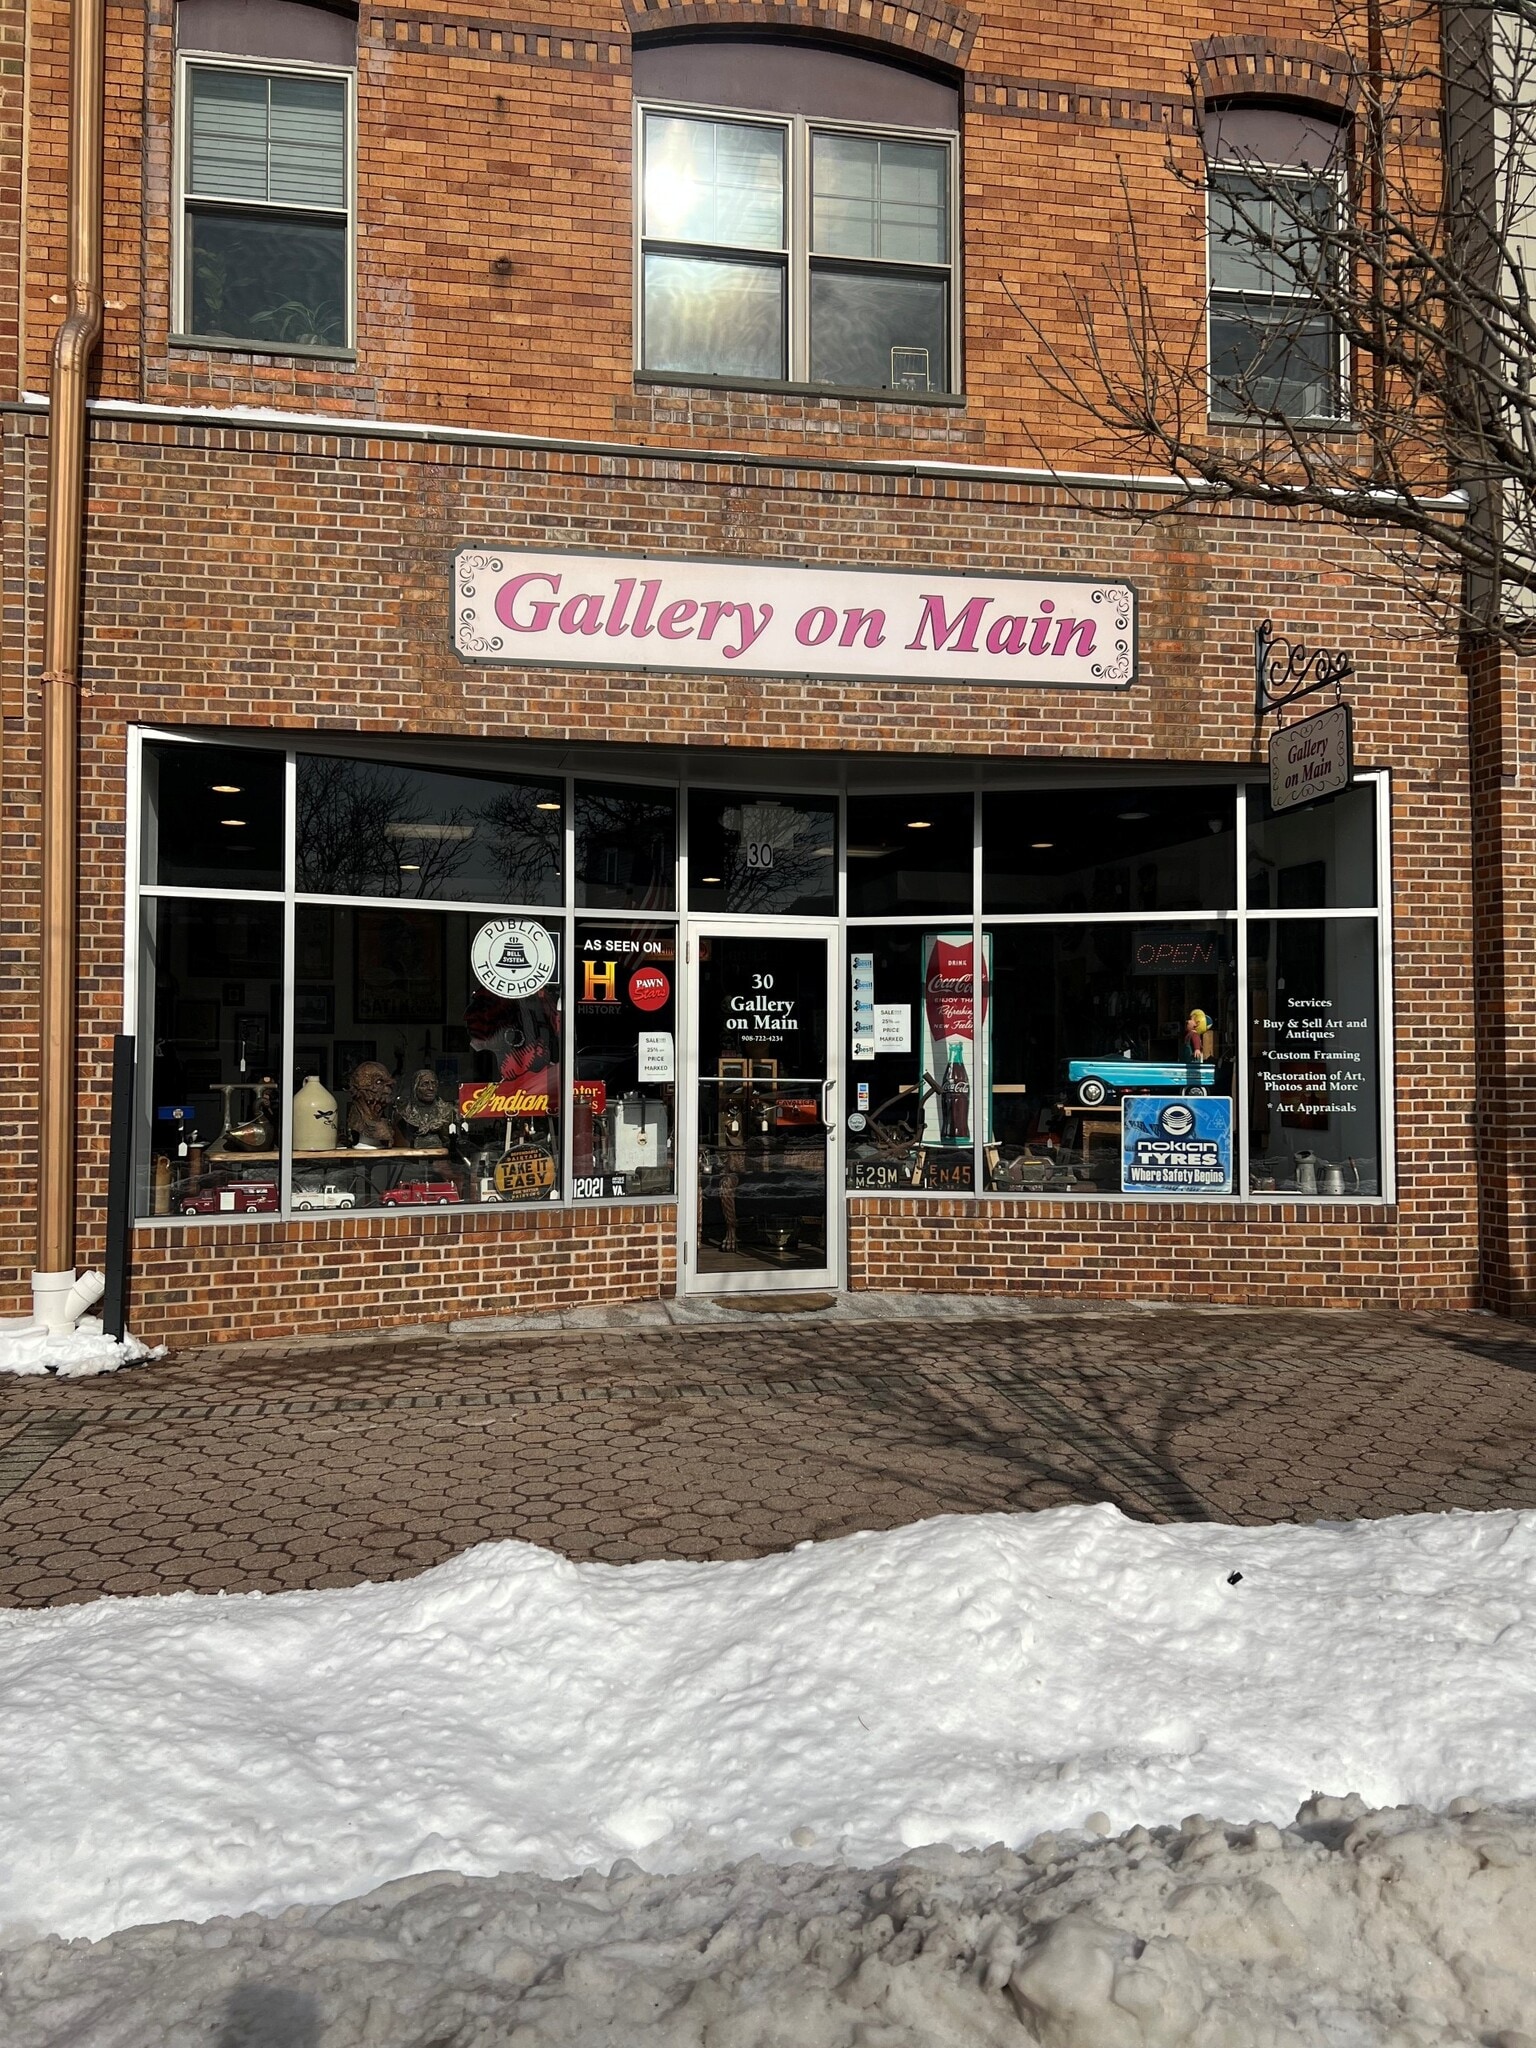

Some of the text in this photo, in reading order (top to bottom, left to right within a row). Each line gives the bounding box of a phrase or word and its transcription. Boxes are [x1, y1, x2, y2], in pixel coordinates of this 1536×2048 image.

[494, 572, 1098, 659] Gallery on Main
[1288, 738, 1328, 764] Gallery
[1285, 758, 1331, 789] on Main
[749, 843, 771, 866] 30
[484, 919, 543, 941] PUBLIC
[583, 939, 661, 953] AS SEEN ON
[1137, 943, 1214, 963] OPEN
[478, 961, 549, 993] TELEPHONE
[582, 960, 618, 1001] H
[636, 979, 663, 988] PAWN
[752, 974, 774, 989] 30
[633, 987, 666, 1001] Stars
[577, 1005, 621, 1014] HISTORY
[731, 995, 795, 1017] Gallery
[1287, 998, 1332, 1008] Services
[726, 1014, 799, 1030] on Main
[1263, 1018, 1367, 1031] Buy & Sell Art and
[1286, 1030, 1335, 1041] Antiques
[1313, 1050, 1361, 1062] Framing
[1330, 1071, 1342, 1081] of
[1344, 1071, 1366, 1082] Art,
[1265, 1081, 1359, 1091] Photos and More
[462, 1085, 549, 1115] Indian
[1276, 1102, 1357, 1115] Art Appraisals
[1138, 1152, 1218, 1166] TYRES
[501, 1160, 548, 1176] TAKE IT
[503, 1172, 547, 1189] EASY
[1131, 1168, 1224, 1184] Where Safety Begins
[612, 1185, 626, 1196] VA.
